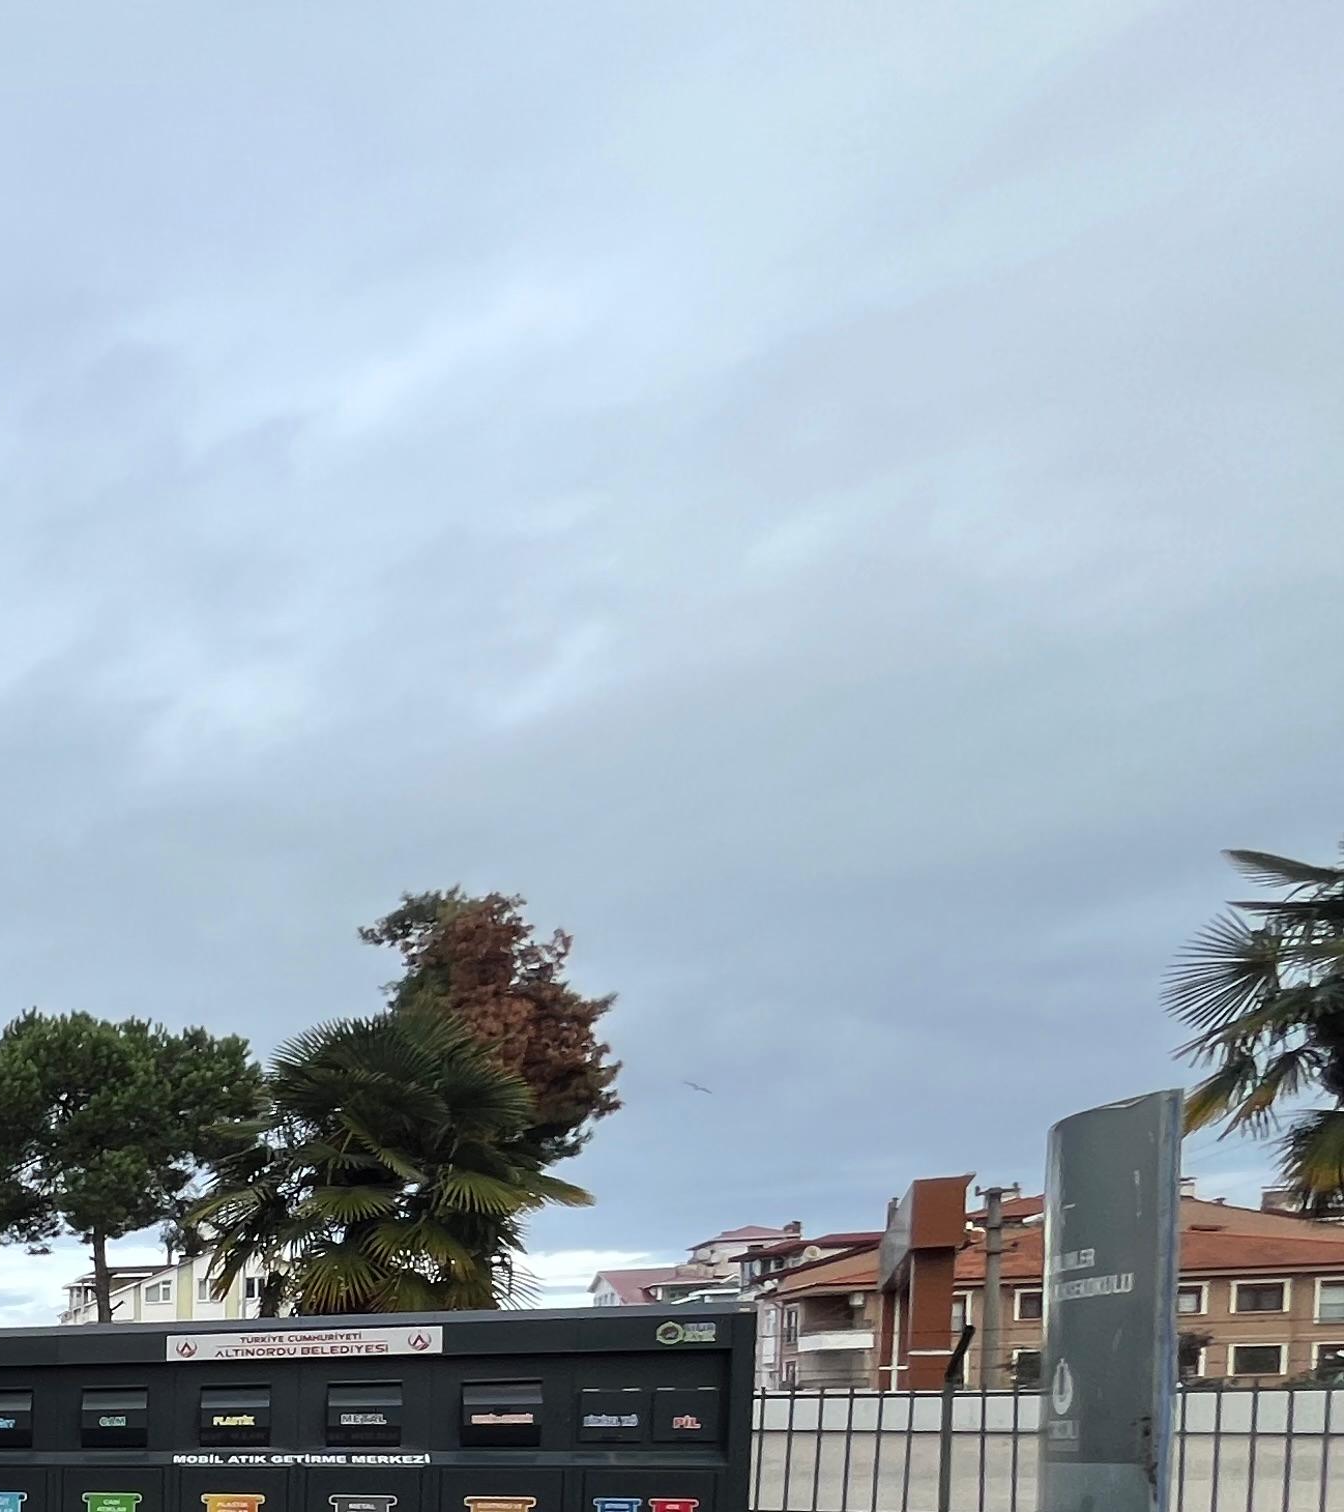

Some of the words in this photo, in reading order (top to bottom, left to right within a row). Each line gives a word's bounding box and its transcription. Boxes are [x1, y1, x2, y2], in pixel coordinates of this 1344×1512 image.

[672, 1414, 702, 1429] PİL
[173, 1453, 224, 1464] MOBİL
[228, 1455, 266, 1464] ATIK
[270, 1453, 347, 1464] GETİRME
[351, 1453, 431, 1464] MERKEZİ
